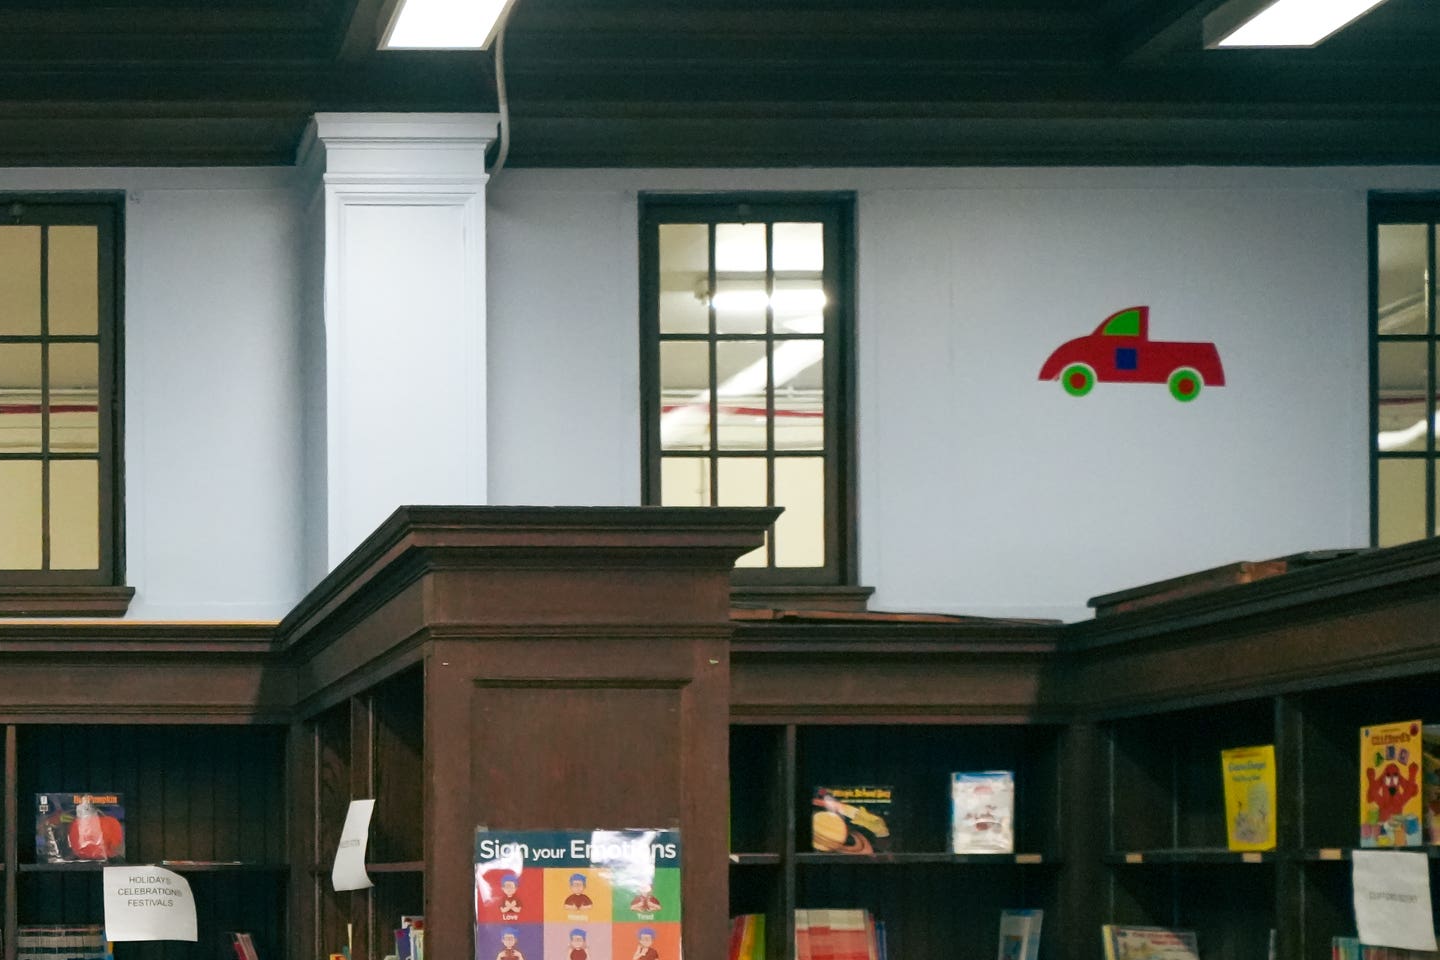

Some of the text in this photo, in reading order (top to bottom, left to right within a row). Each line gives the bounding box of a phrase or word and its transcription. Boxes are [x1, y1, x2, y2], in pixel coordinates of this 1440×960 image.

[532, 847, 566, 861] your
[128, 876, 171, 884] HOLIDAYS
[117, 888, 182, 897] CELEBRATIONS
[127, 899, 173, 907] FESTIVALS
[502, 913, 518, 921] Love
